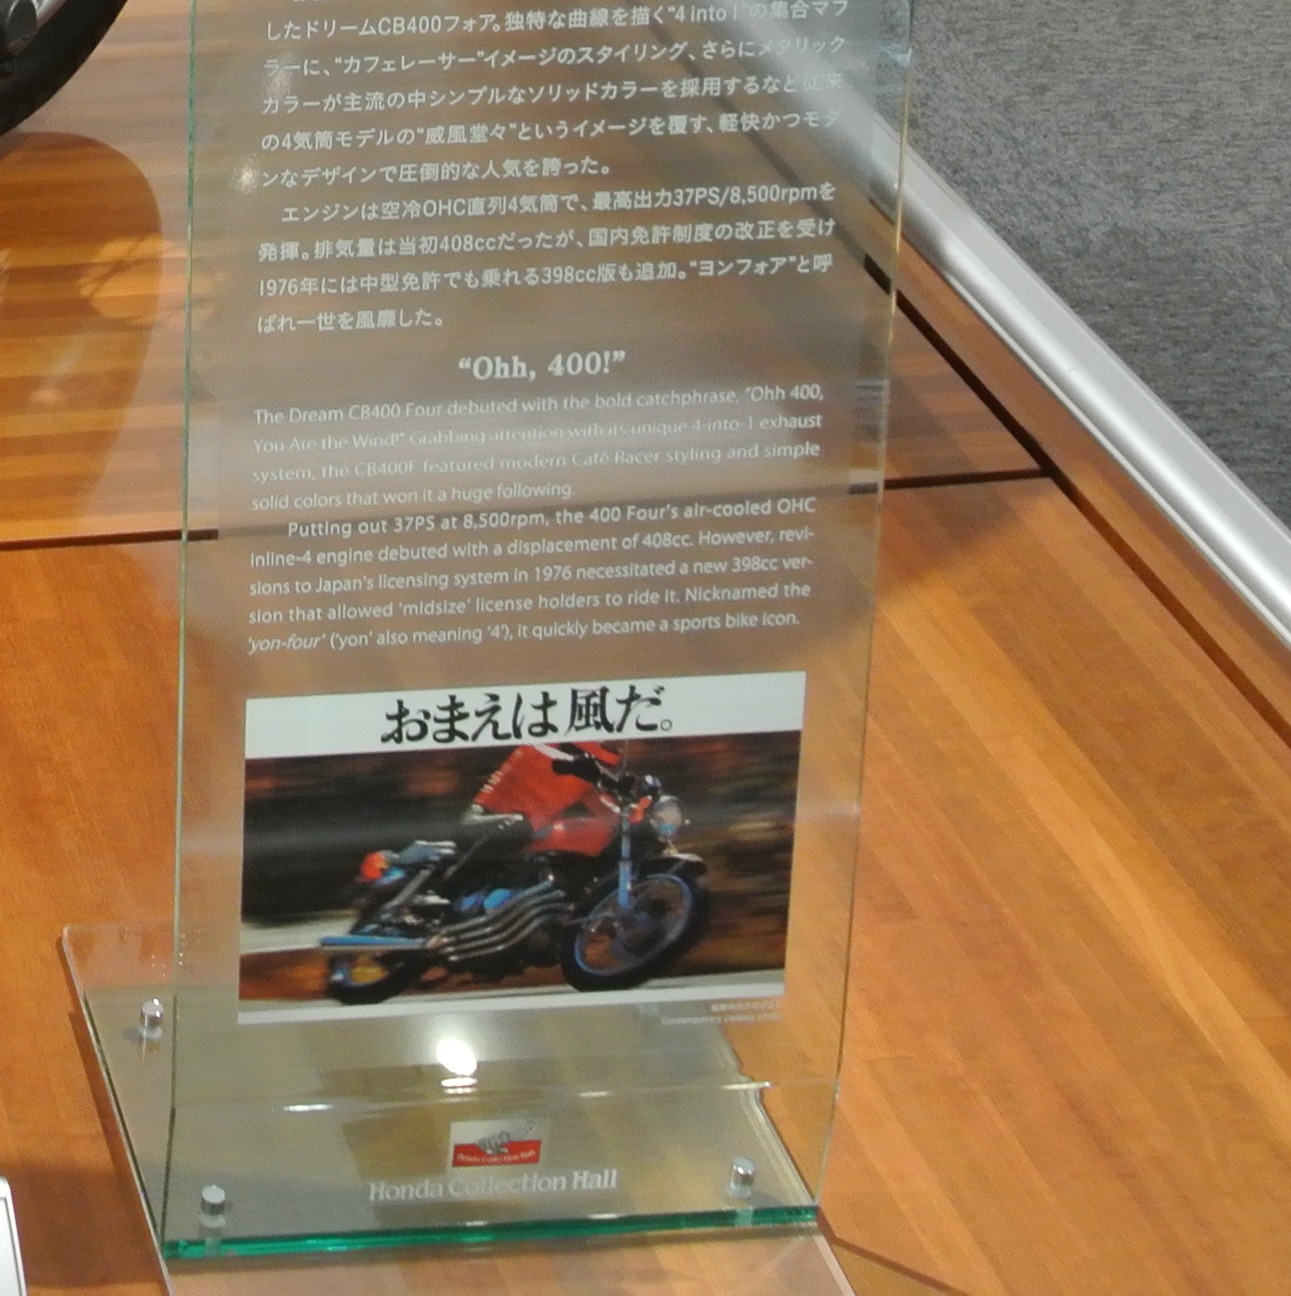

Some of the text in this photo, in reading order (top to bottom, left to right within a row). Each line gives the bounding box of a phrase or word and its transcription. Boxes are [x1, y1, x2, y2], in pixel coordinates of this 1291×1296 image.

[457, 350, 626, 382] “Ohh, 400!”
[253, 408, 284, 426] The
[288, 407, 344, 424] Dream
[348, 403, 401, 421] CB400
[405, 402, 442, 418] Four
[446, 398, 517, 417] debuted
[522, 396, 558, 413] with
[562, 395, 592, 411] the
[594, 391, 632, 410] bold
[253, 438, 284, 455] You
[289, 436, 317, 453] Are
[320, 434, 348, 451] the
[568, 422, 605, 438] with
[630, 420, 687, 437] unique
[759, 413, 823, 431] exhaust
[251, 466, 317, 485] system,
[320, 462, 350, 480] the
[422, 457, 495, 475] featured
[500, 453, 567, 470] modern
[614, 449, 660, 466] Racer
[666, 445, 723, 466] styling
[727, 443, 760, 460] and
[764, 440, 821, 460] simple
[251, 481, 575, 512] solid colors that won it a huge following.
[287, 521, 353, 540] Putting
[357, 520, 387, 535] out
[393, 514, 435, 533] 37PS
[440, 517, 458, 531] at
[555, 507, 584, 526] the
[589, 506, 621, 523] 400
[683, 498, 771, 519] air-cooled
[777, 496, 816, 514] OHC
[316, 550, 373, 568] engine
[377, 543, 448, 562] debuted
[452, 540, 489, 557] with
[492, 543, 503, 556] a
[506, 534, 617, 557] displacement
[621, 532, 640, 549] of
[698, 528, 774, 546] However,
[778, 525, 815, 542] revi-
[249, 580, 291, 596] sions
[294, 578, 312, 594] to
[378, 572, 449, 591] licensing
[453, 569, 509, 588] system
[513, 567, 529, 583] in
[534, 564, 572, 582] 1976
[575, 559, 675, 580] necessitated
[678, 562, 689, 575] a
[693, 559, 728, 574] new
[731, 555, 779, 572] 398cc
[782, 556, 813, 570] ver-
[248, 608, 283, 625] sion
[288, 606, 323, 622] that
[326, 601, 394, 620] allowed
[475, 595, 533, 613] license
[538, 591, 601, 611] holders
[604, 593, 623, 607] to
[626, 588, 661, 605] ride
[685, 582, 778, 602] Nicknamed
[783, 581, 811, 598] the
[376, 628, 409, 646] also
[411, 626, 483, 645] meaning
[517, 622, 529, 639] it
[531, 620, 589, 641] quickly
[591, 617, 656, 635] became
[659, 620, 669, 633] a
[672, 614, 721, 634] sports
[724, 611, 758, 629] bike
[762, 610, 800, 627] icon.
[380, 684, 673, 744] おまえは風だ。
[369, 1168, 618, 1202] Honda Collection Hall
